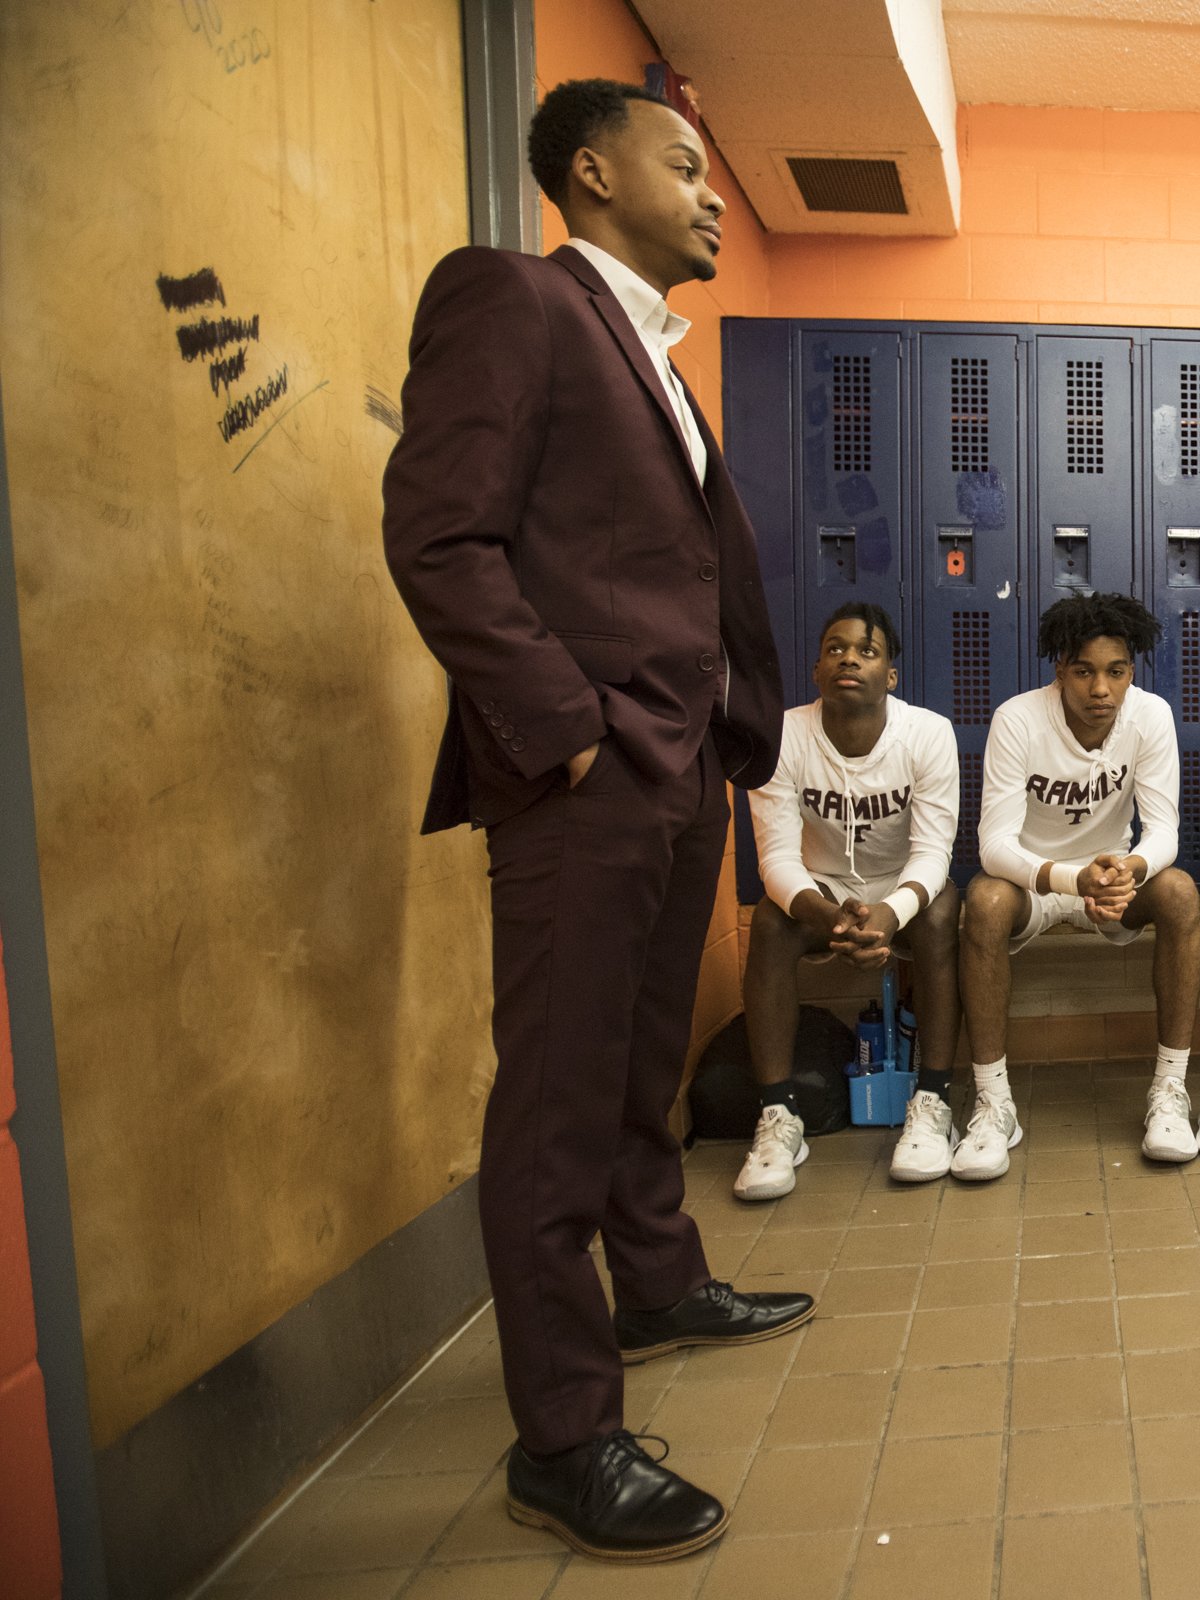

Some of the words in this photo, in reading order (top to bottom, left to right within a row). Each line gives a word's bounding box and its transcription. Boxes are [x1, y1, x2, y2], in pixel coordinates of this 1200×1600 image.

[1026, 765, 1127, 805] RAMILY
[803, 785, 910, 820] RAMILY
[1065, 808, 1091, 825] T
[844, 824, 871, 842] T
